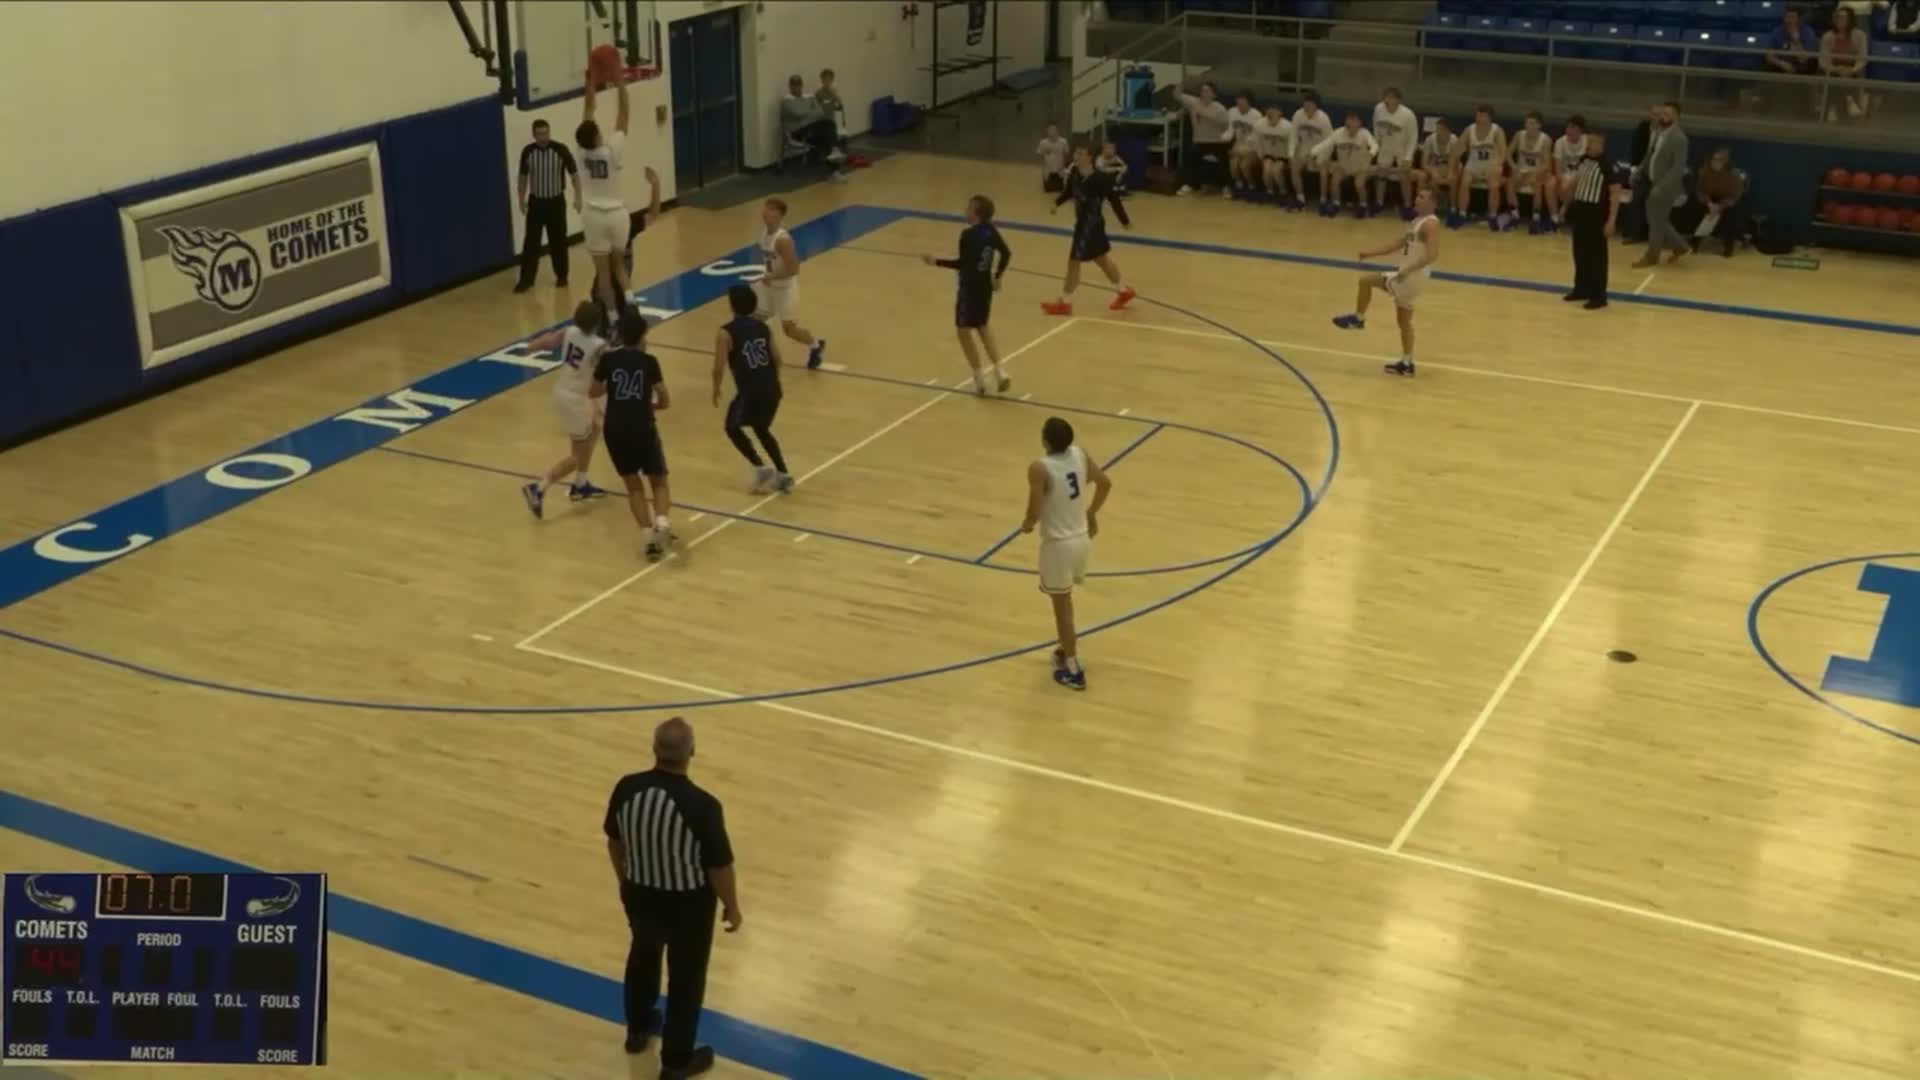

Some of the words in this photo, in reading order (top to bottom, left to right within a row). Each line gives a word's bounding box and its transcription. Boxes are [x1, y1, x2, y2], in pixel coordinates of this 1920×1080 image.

[266, 217, 313, 244] HOME
[315, 209, 336, 228] OF
[337, 200, 366, 224] THE
[269, 216, 370, 270] COMETS
[217, 257, 253, 295] M
[564, 342, 585, 368] 12
[741, 337, 770, 370] 15
[611, 367, 645, 401] 24
[1066, 471, 1080, 501] 3
